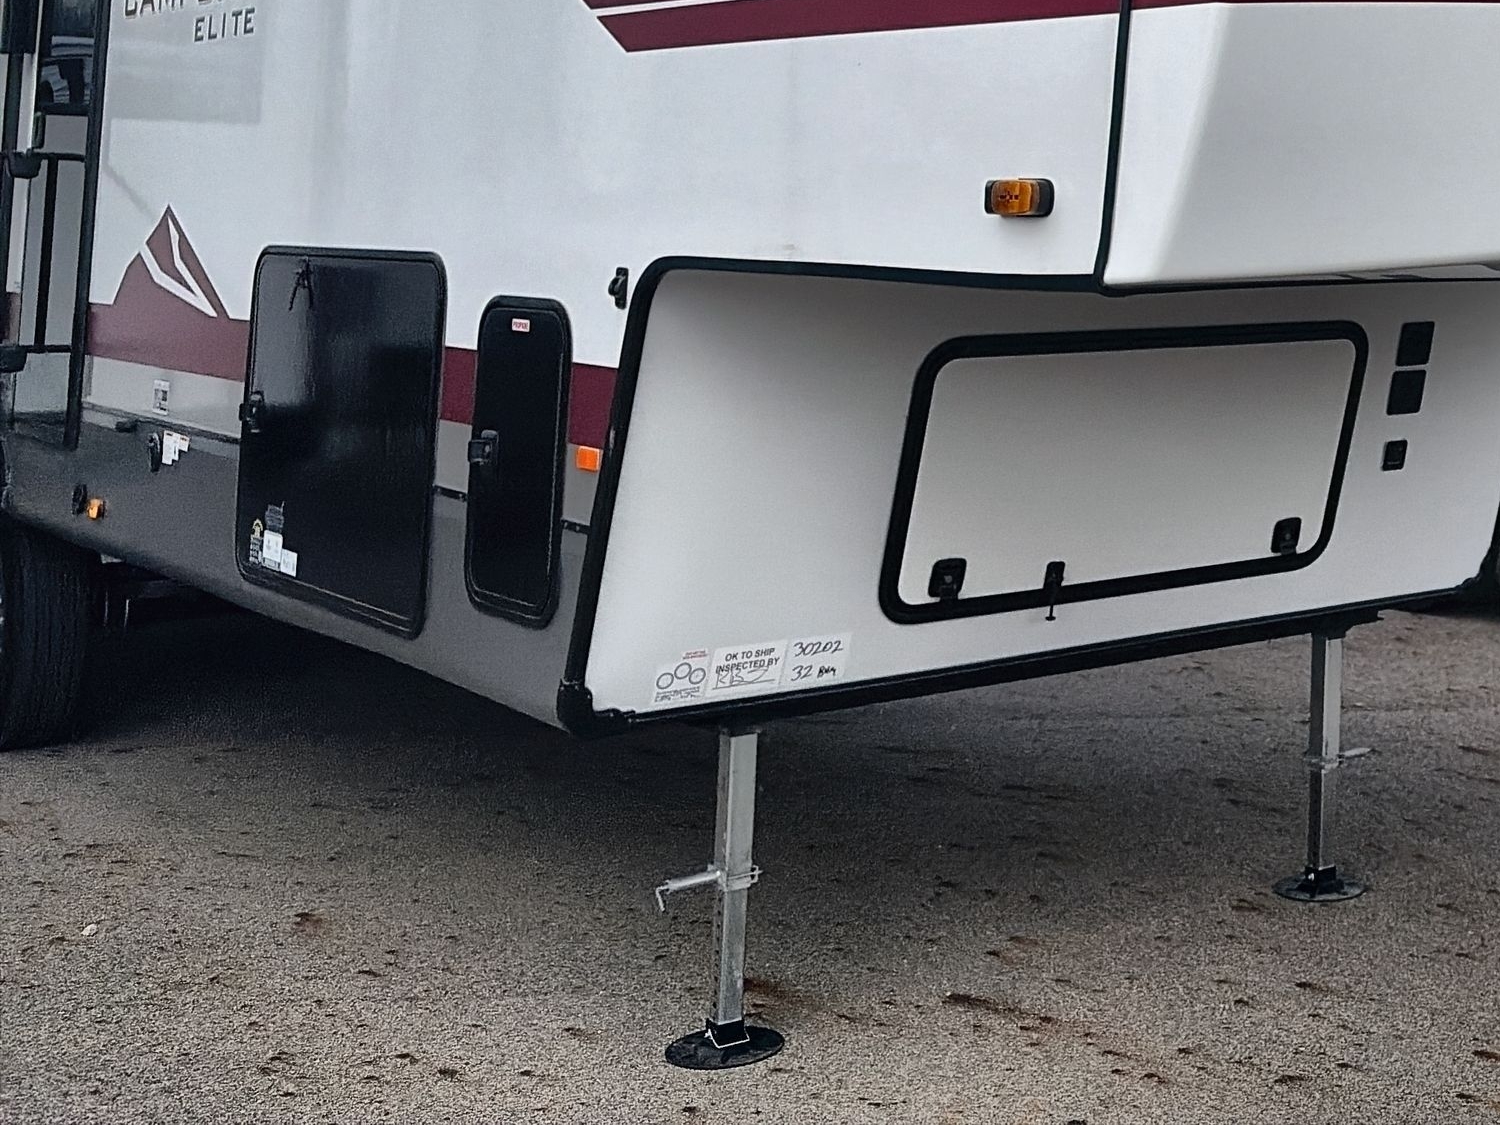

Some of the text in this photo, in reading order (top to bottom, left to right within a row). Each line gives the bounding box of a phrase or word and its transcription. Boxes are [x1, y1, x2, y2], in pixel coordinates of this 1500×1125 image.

[194, 7, 255, 42] ELITE
[725, 647, 775, 662] OK TO SHIP
[793, 640, 843, 657] 30202
[715, 657, 780, 674] INSPECTED BY
[791, 664, 813, 681] 32
